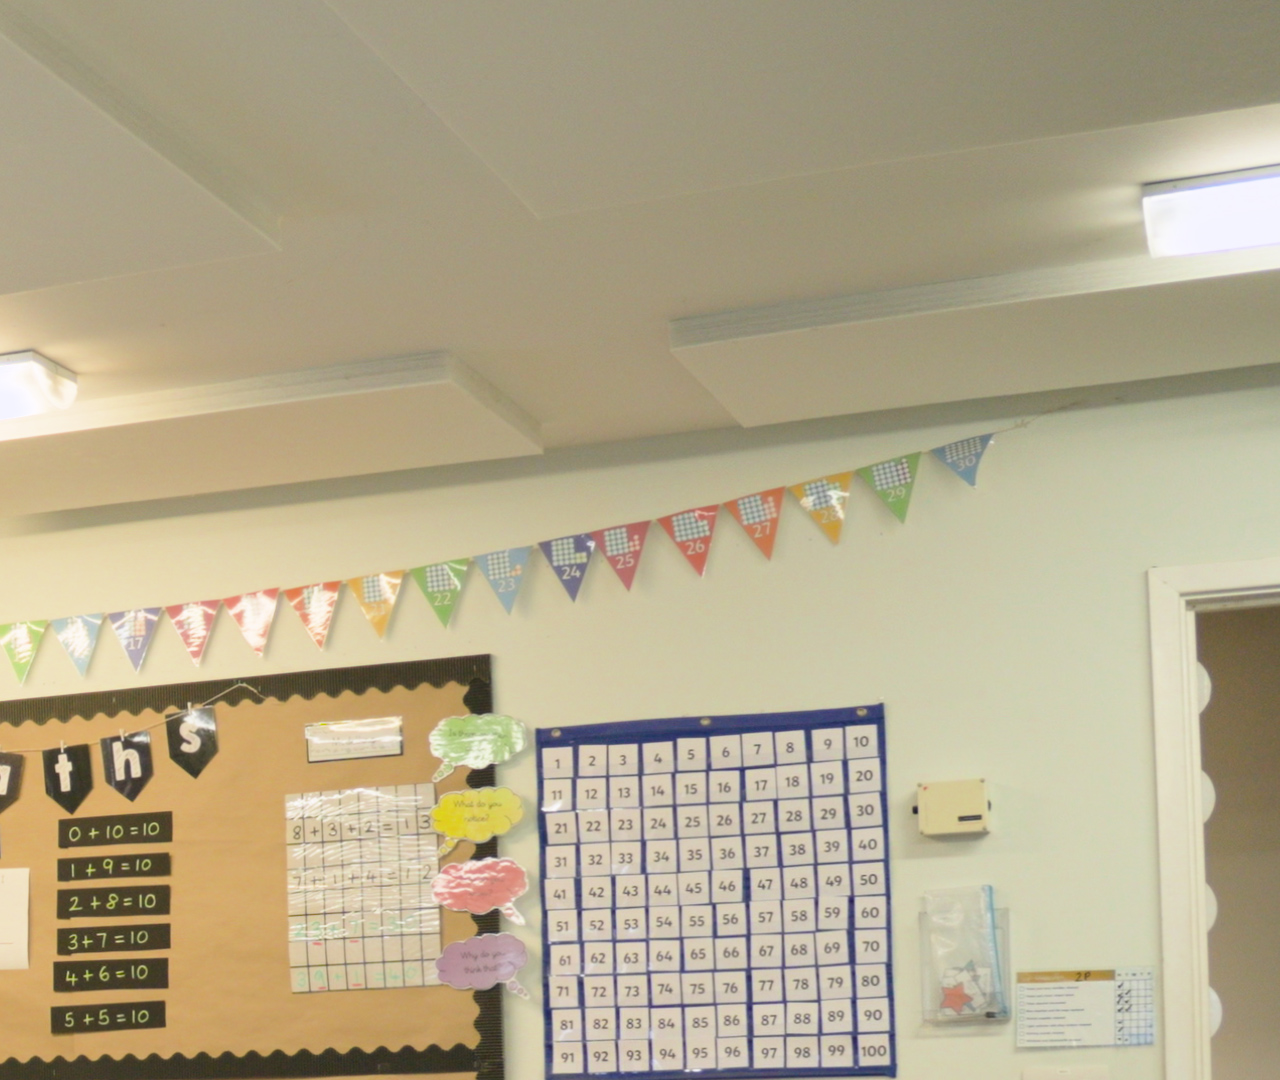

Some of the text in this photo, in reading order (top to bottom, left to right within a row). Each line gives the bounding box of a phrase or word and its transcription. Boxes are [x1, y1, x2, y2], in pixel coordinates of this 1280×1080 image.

[561, 522, 772, 580] 27 25 24
[853, 735, 870, 748] 10
[855, 769, 873, 782] 20
[586, 820, 601, 833] 22
[687, 849, 703, 861] 35
[757, 878, 773, 891] 47
[790, 943, 808, 956] 68
[860, 1044, 887, 1058] 100
[560, 1052, 575, 1064] 91
